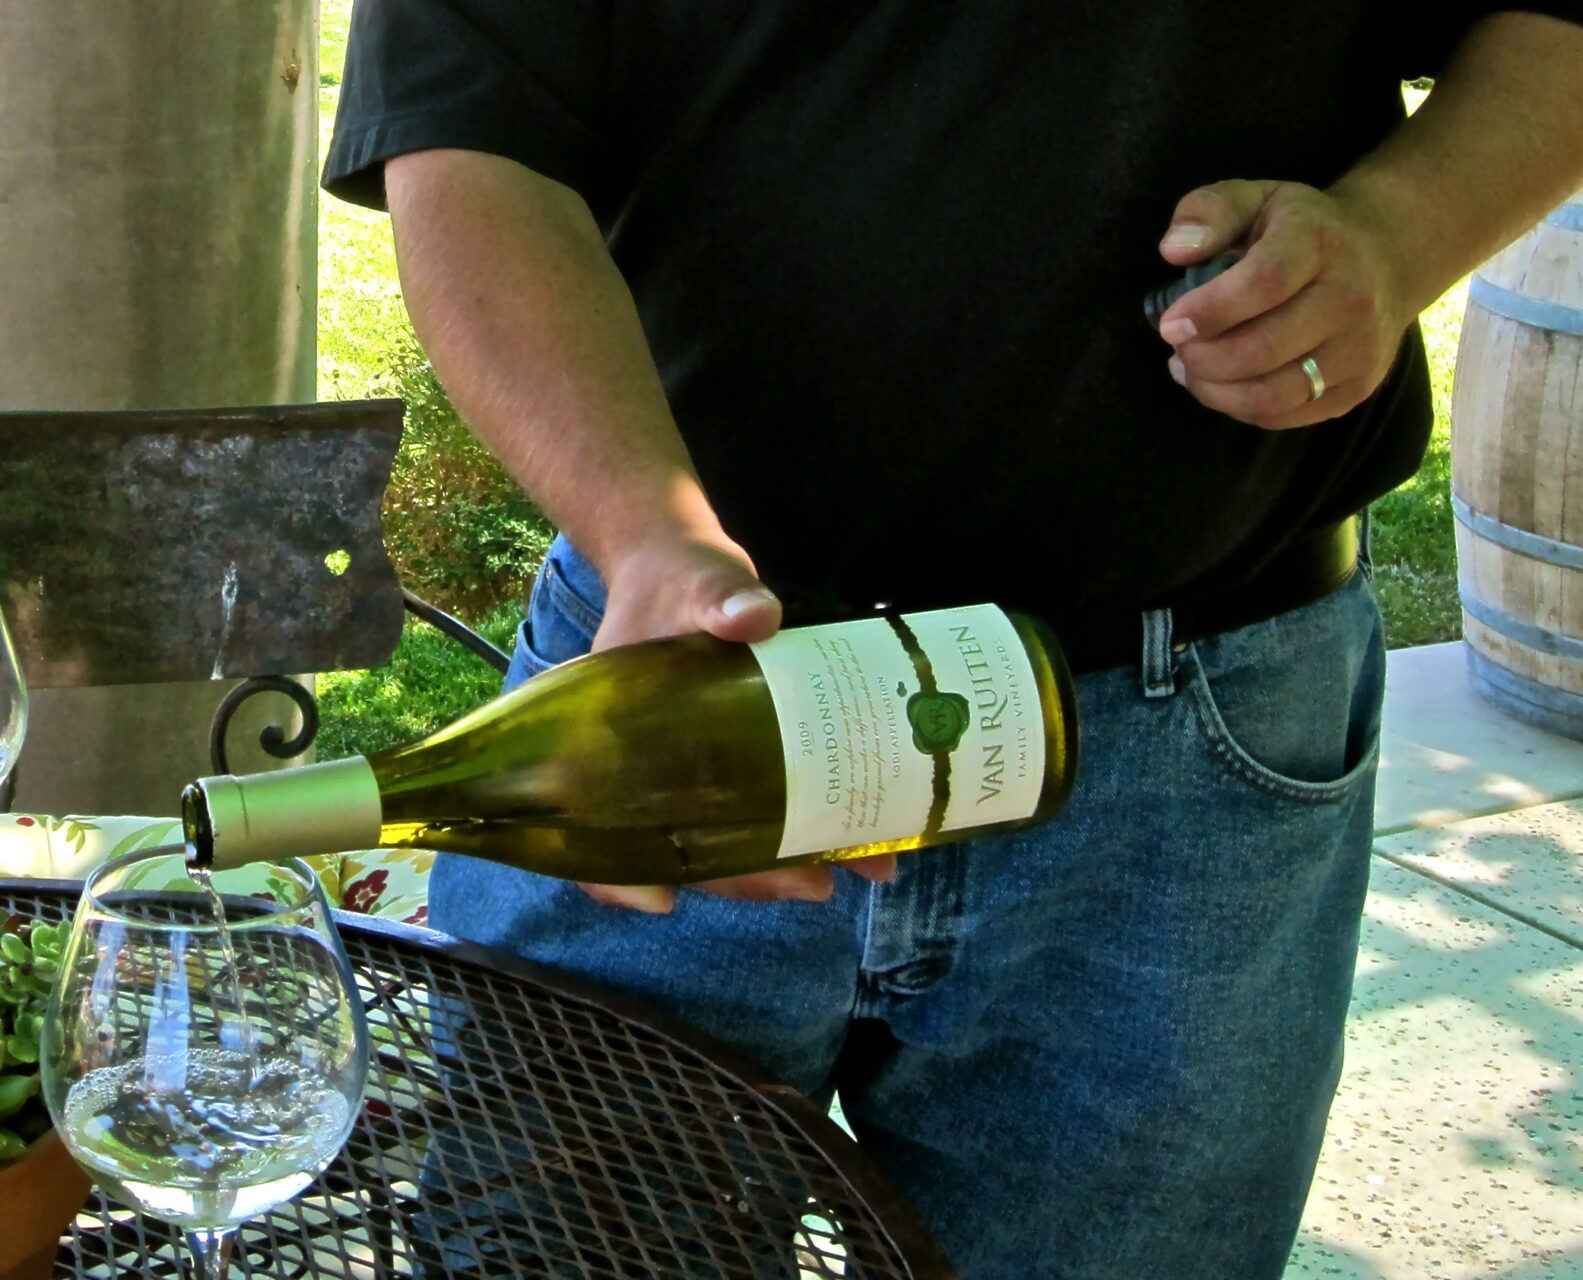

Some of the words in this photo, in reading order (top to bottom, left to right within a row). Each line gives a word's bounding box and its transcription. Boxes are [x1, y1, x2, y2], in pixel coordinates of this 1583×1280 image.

[877, 676, 900, 748] APPELLATION
[949, 626, 1008, 731] RUITEN
[994, 638, 1024, 718] VINEYARDS
[799, 721, 813, 757] 2009
[808, 672, 840, 805] CHARDONNAY
[1017, 727, 1027, 778] FAMILY
[976, 745, 1004, 806] VAN
